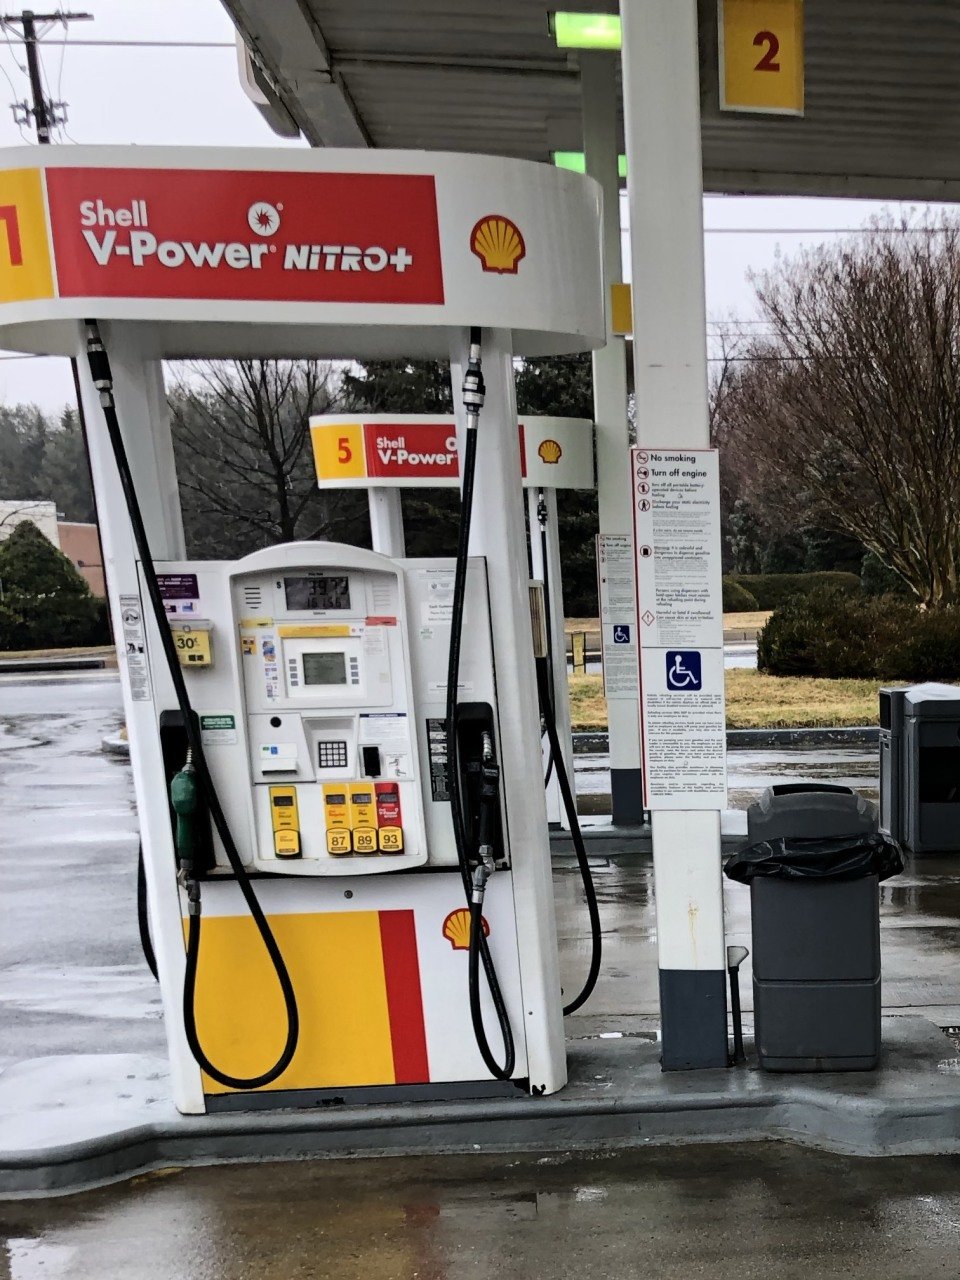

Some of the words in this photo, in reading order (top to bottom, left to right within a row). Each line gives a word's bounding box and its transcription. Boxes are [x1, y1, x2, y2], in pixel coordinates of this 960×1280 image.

[752, 31, 780, 72] 2
[80, 199, 148, 227] Shell
[82, 230, 269, 270] V-Power
[377, 437, 405, 449] Shell
[338, 438, 352, 464] 5
[379, 450, 454, 465] V-Power
[650, 454, 662, 462] No
[664, 453, 696, 464] smoking
[651, 468, 667, 476] Turn
[668, 468, 680, 476] off
[681, 469, 707, 479] engine
[331, 836, 345, 846] 87
[358, 836, 372, 845] 89
[383, 834, 398, 844] 93
